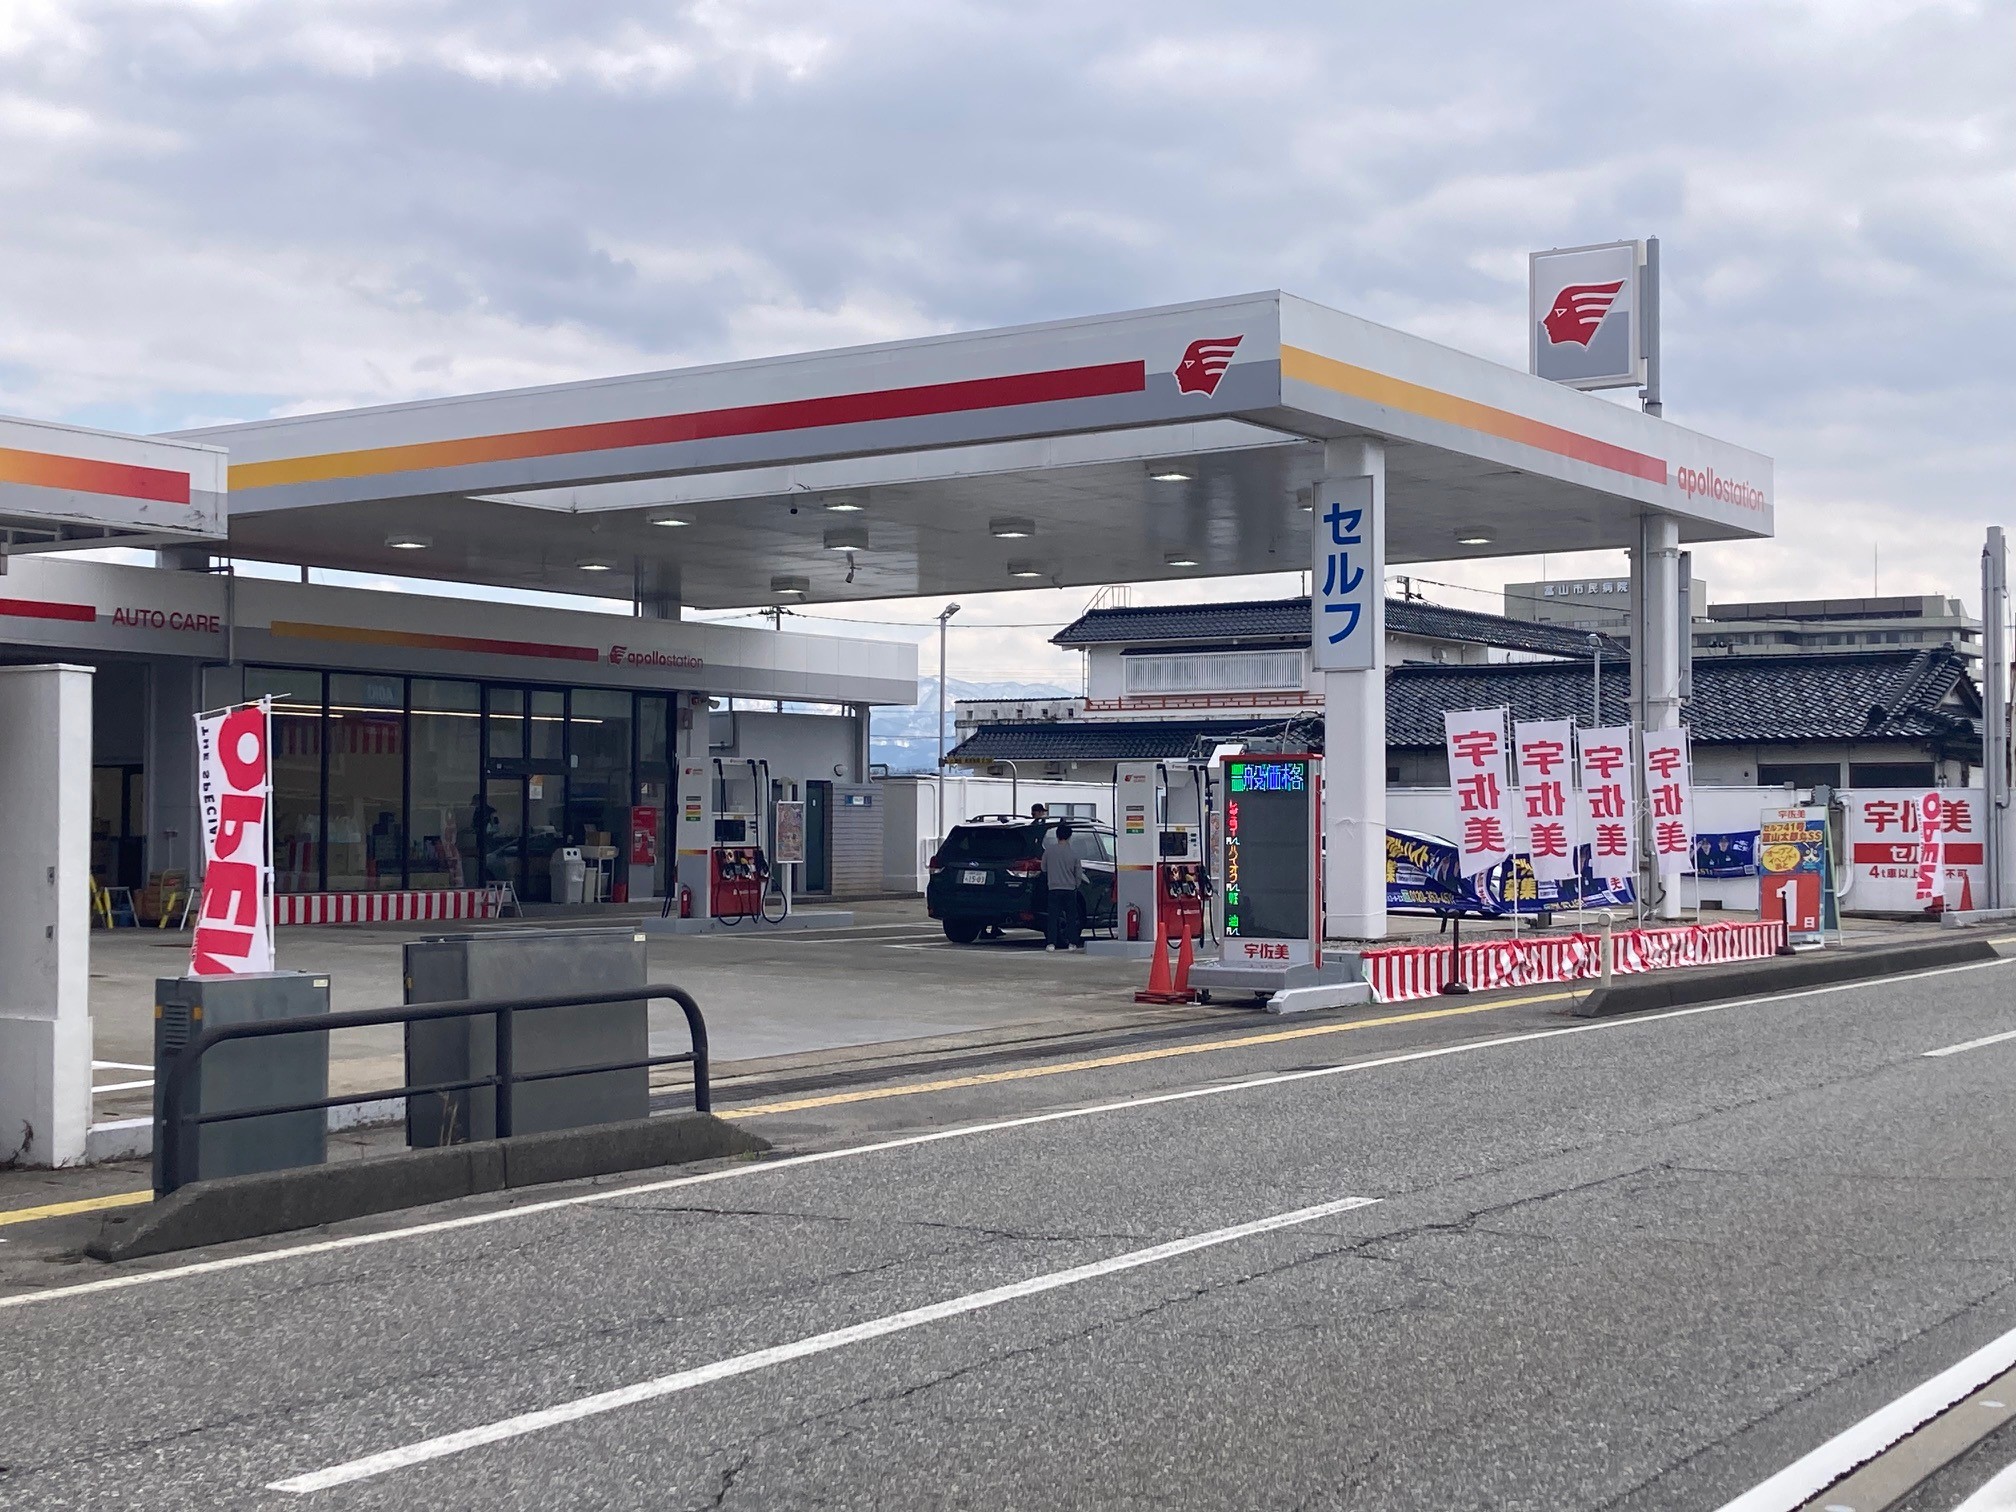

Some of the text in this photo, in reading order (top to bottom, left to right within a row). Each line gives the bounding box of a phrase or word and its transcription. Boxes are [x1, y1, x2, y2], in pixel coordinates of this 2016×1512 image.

[1678, 466, 1765, 512] apollostation
[1322, 502, 1365, 645] セルフ
[1544, 581, 1629, 597] 富山市民病院
[112, 607, 220, 633] AUTO CARE
[627, 650, 704, 669] apollostation
[1230, 763, 1304, 792] 一般価格
[1778, 809, 1806, 819] 宇佐美
[1776, 880, 1815, 929] 1 日
[1244, 943, 1290, 960] 宇佐美
